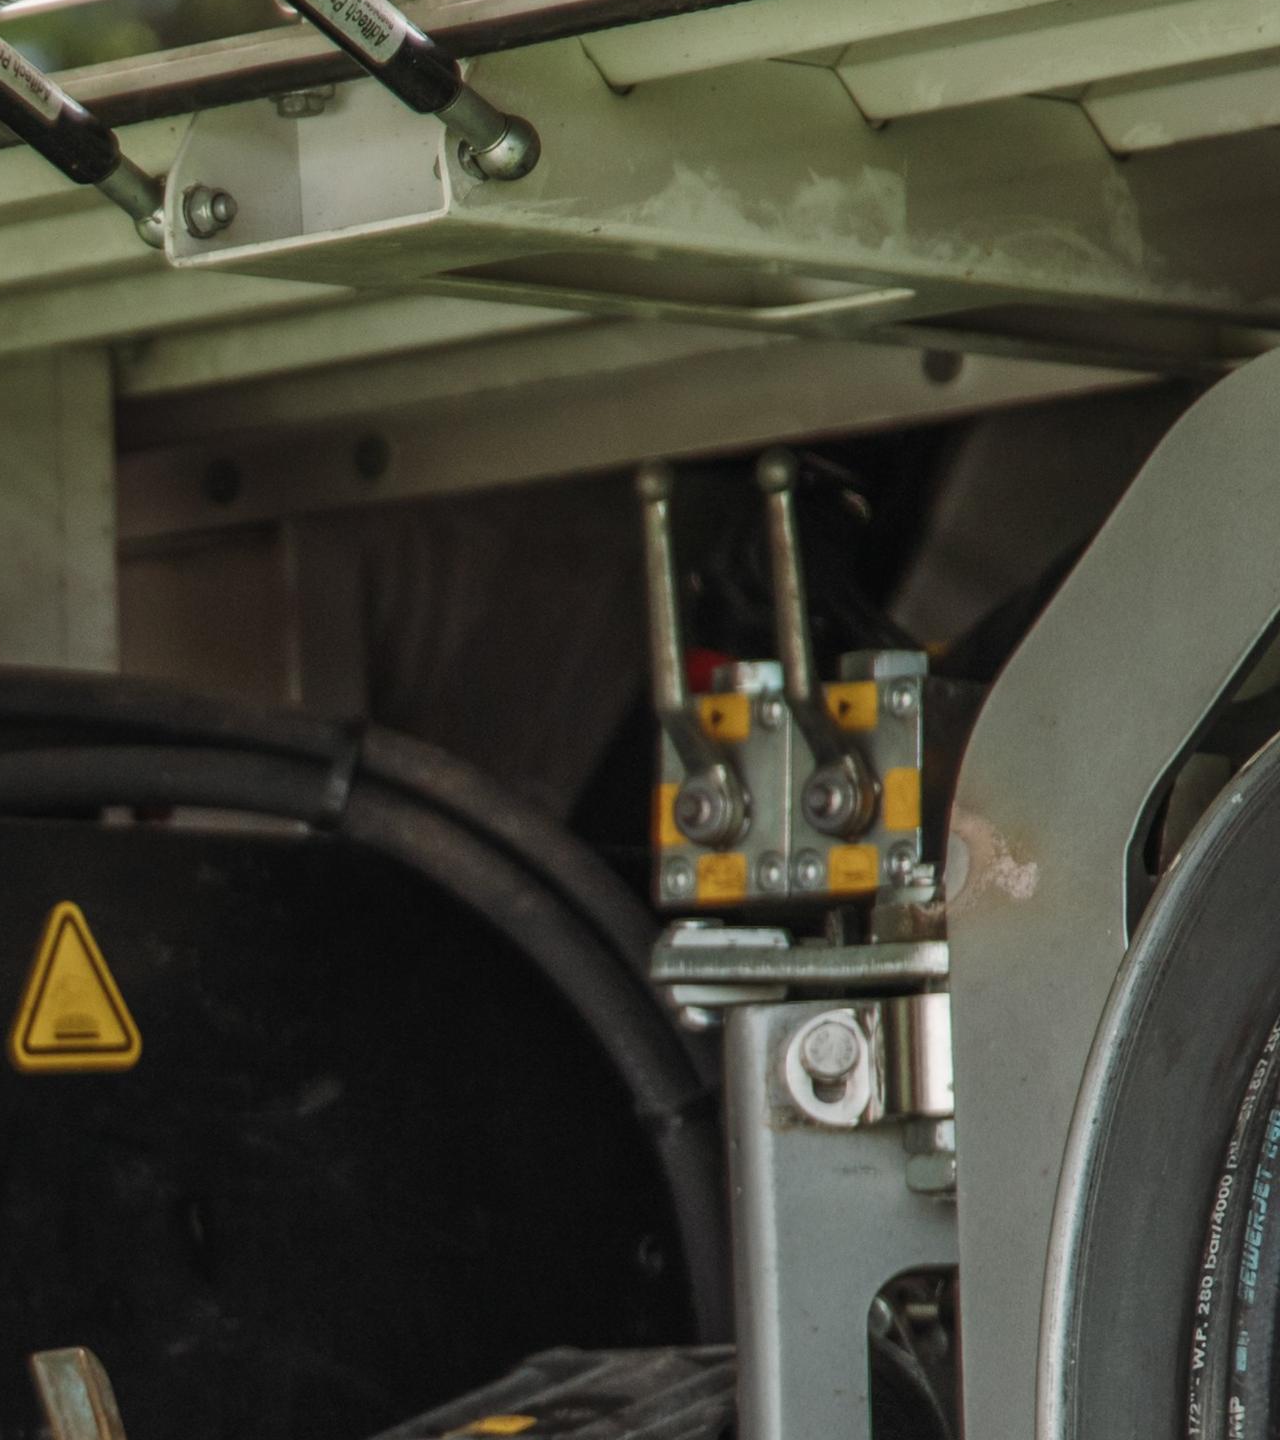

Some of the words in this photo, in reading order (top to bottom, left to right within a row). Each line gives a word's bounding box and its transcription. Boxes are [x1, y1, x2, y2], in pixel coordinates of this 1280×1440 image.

[341, 2, 390, 47] Aditech
[1204, 1173, 1233, 1268] bar/4000
[1198, 1275, 1213, 1314] 280
[1192, 1321, 1208, 1368] W.P.
